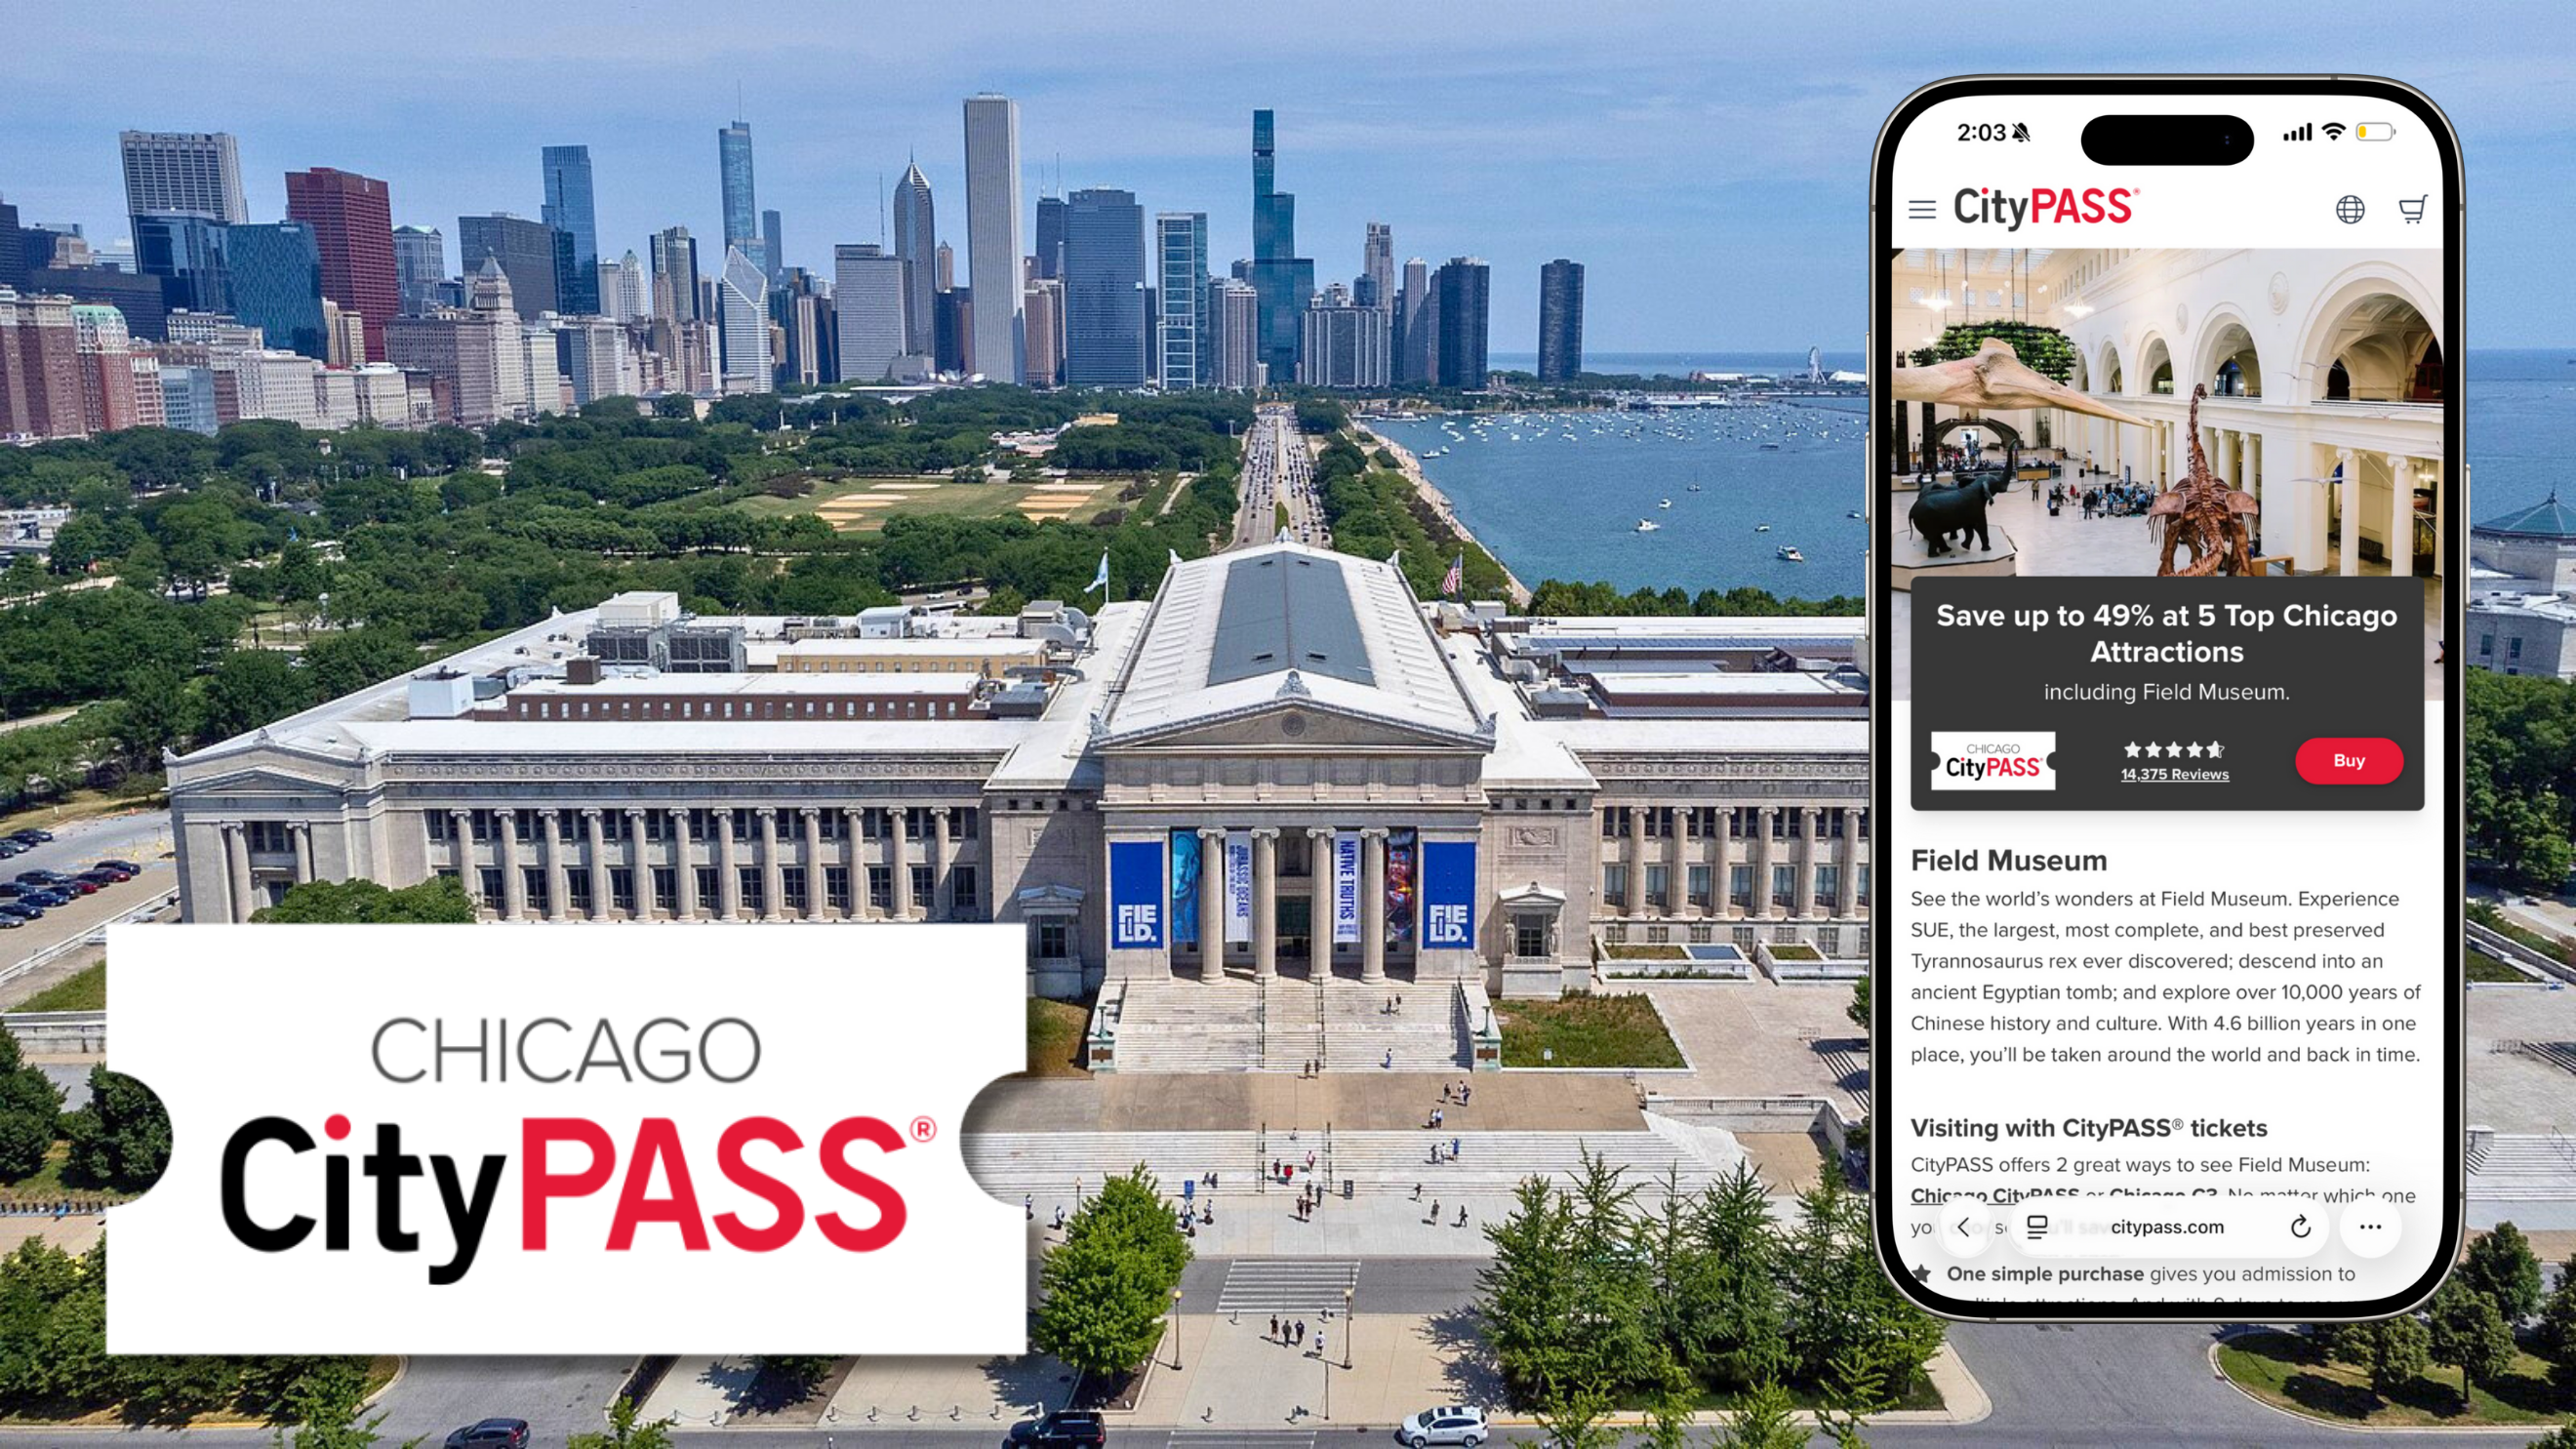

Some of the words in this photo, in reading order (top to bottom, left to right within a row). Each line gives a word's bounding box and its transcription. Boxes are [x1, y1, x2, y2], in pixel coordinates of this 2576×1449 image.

[1957, 123, 2007, 142] 2:03
[1937, 603, 2006, 627] Save
[2014, 609, 2050, 632] up
[2056, 605, 2085, 627] to
[2093, 603, 2154, 627] 49%
[2162, 605, 2190, 627] at
[2198, 603, 2216, 627] 5
[2224, 603, 2275, 632] Top
[2282, 603, 2398, 632] Chicago
[2090, 639, 2244, 664] Attractions
[2044, 683, 2136, 705] including
[2144, 683, 2192, 701] Field
[2198, 683, 2290, 701] Museum.
[1966, 744, 2021, 754] CHICAGO
[2334, 753, 2366, 771] Buy
[2120, 768, 2168, 781] 14,375
[2171, 768, 2230, 781] Reviews
[1236, 845, 1249, 885] JURASSIC
[1339, 841, 1355, 877] NATIVE
[1912, 848, 1979, 872] Field
[1988, 848, 2108, 872] Museum
[1236, 886, 1249, 918] OCEANS
[1339, 878, 1355, 920] TRUTHS
[1911, 890, 1947, 907] See
[1951, 891, 1981, 907] the
[1985, 890, 2050, 907] world’s
[2054, 891, 2134, 907] wonders
[2139, 892, 2156, 906] at
[2161, 890, 2205, 907] Field
[2211, 890, 2292, 907] Museum.
[2299, 890, 2400, 910] Experience
[1911, 921, 1954, 941] SUE,
[1958, 921, 1989, 938] the
[1993, 921, 2060, 942] largest,
[2065, 923, 2110, 938] most
[2114, 921, 2204, 942] complete,
[2209, 921, 2243, 938] and
[2249, 922, 2289, 938] best
[2293, 921, 2385, 942] preserved
[1911, 952, 2044, 973] Tyrannosaurus
[2049, 956, 2077, 969] rex
[2082, 956, 2123, 969] ever
[2128, 952, 2234, 971] discovered;
[2238, 952, 2316, 969] descend
[2322, 953, 2356, 969] into
[2361, 956, 2384, 969] an
[1911, 985, 1978, 1000] ancient
[1983, 984, 2061, 1004] Egyptian
[2066, 984, 2117, 1002] tomb;
[2122, 984, 2156, 1000] and
[2162, 984, 2231, 1004] explore
[2235, 987, 2277, 1000] over
[2281, 984, 2344, 1002] 10,000
[2348, 987, 2398, 1004] years
[2403, 984, 2422, 1000] of
[1911, 1015, 1985, 1031] Chinese
[1991, 1015, 2051, 1035] history
[2056, 1015, 2090, 1031] and
[2095, 1015, 2162, 1031] culture.
[2167, 1015, 2208, 1031] With
[2213, 1015, 2242, 1031] 4.6
[2247, 1015, 2301, 1031] billion
[2306, 1019, 2355, 1035] years
[2361, 1016, 2377, 1031] in
[2382, 1019, 2417, 1031] one
[1912, 1046, 1965, 1067] place,
[1969, 1046, 2017, 1067] you’ll
[2023, 1046, 2046, 1063] be
[2050, 1046, 2102, 1063] taken
[2107, 1046, 2171, 1063] around
[2176, 1046, 2206, 1063] the
[2211, 1046, 2261, 1063] world
[2267, 1046, 2301, 1063] and
[2307, 1046, 2350, 1063] back
[2355, 1046, 2371, 1063] in
[2376, 1046, 2421, 1063] time.
[1910, 1117, 1999, 1143] Visiting
[2004, 1117, 2056, 1138] with
[2190, 1117, 2269, 1138] tickets
[1911, 1156, 1993, 1177] CityPASS
[1998, 1156, 2051, 1173] offers
[2056, 1156, 2068, 1173] 2
[2073, 1157, 2121, 1177] great
[2125, 1160, 2172, 1177] ways
[2176, 1157, 2195, 1173] to
[2200, 1160, 2234, 1173] see
[2238, 1156, 2282, 1173] Field
[2288, 1156, 2370, 1173] Museum:
[2382, 1190, 2417, 1204] one
[2111, 1219, 2225, 1238] citypass.com
[1947, 1266, 1987, 1282] One
[1992, 1266, 2053, 1285] simple
[2059, 1266, 2145, 1285] purchase
[2150, 1266, 2198, 1286] gives
[2202, 1269, 2235, 1286] you
[2241, 1266, 2332, 1282] admission
[2337, 1267, 2356, 1282] to
